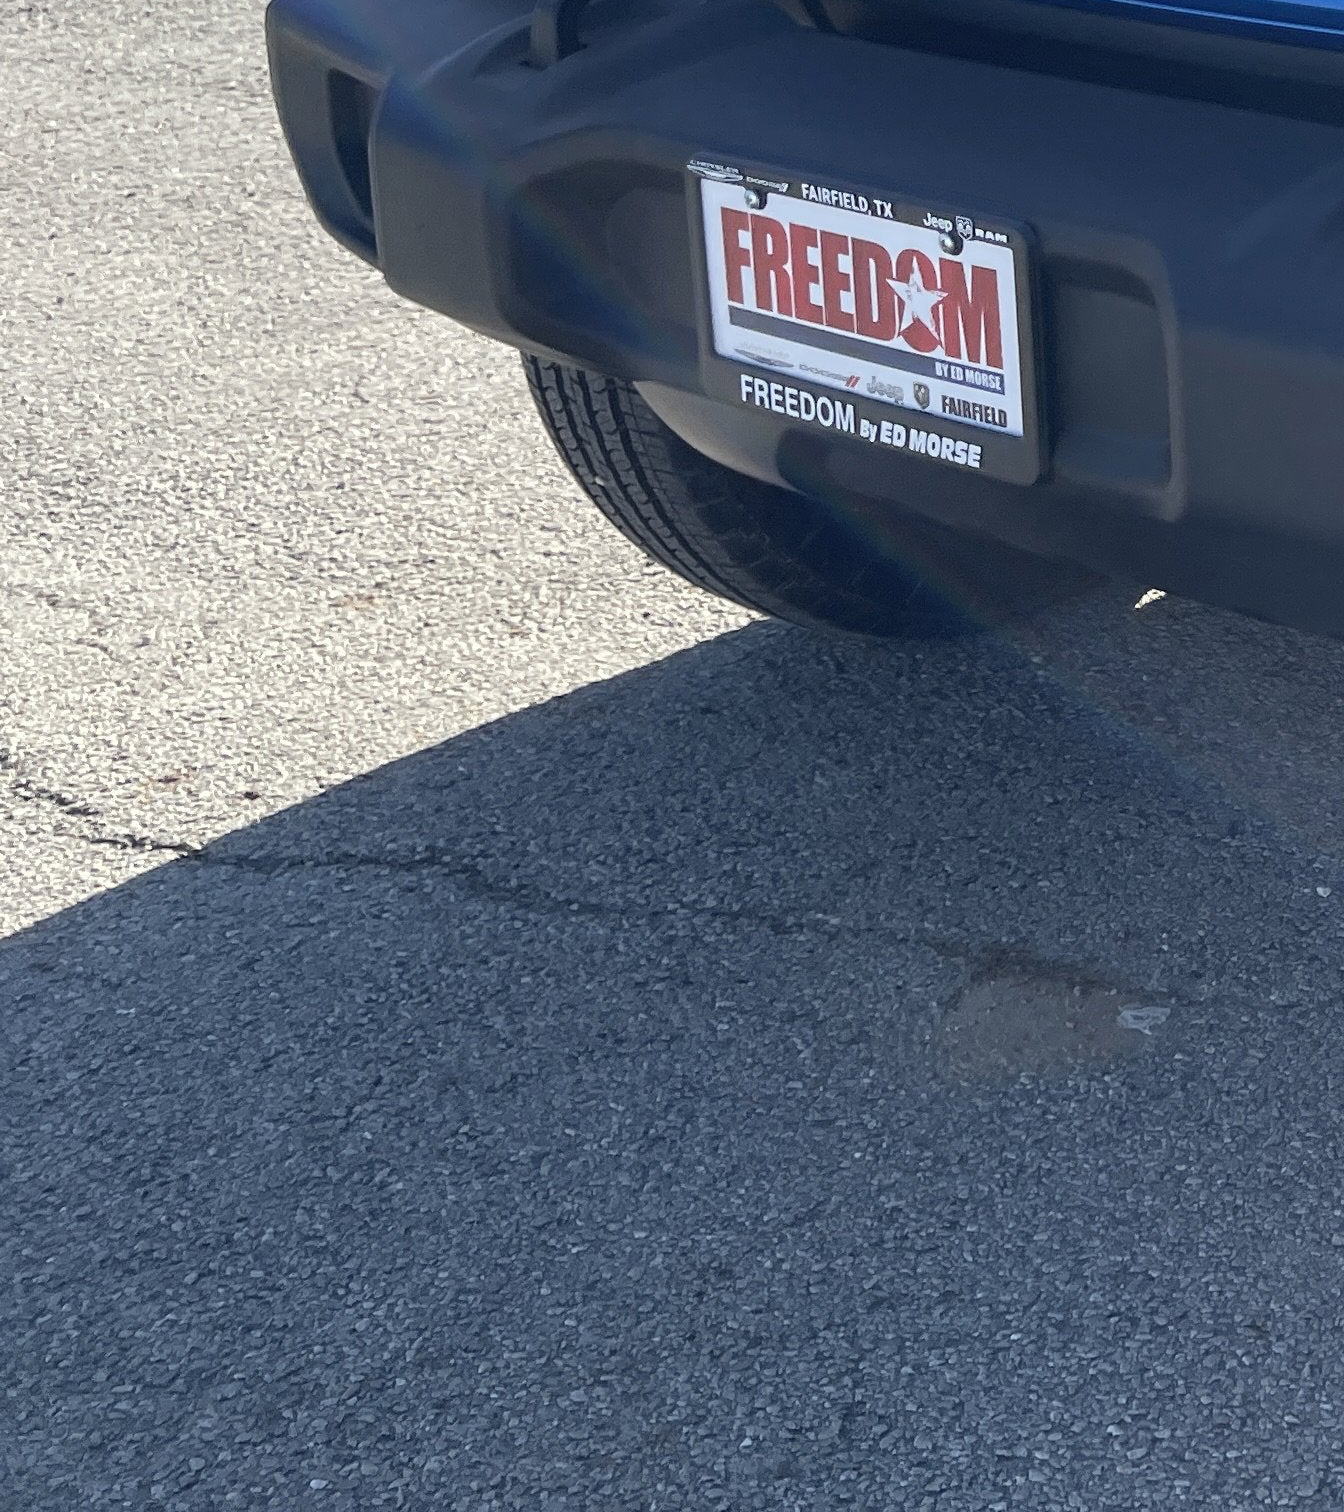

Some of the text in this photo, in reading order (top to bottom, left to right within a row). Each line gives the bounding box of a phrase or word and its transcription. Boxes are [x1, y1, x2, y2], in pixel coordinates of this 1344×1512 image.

[801, 183, 894, 219] FAIRFIELD, TX
[923, 212, 953, 233] Jeep
[720, 206, 1004, 370] FREEDOM
[866, 375, 905, 405] Jeep
[935, 360, 1002, 391] BY ED MORSE
[740, 373, 982, 469] FREEDOM By ED MORSE
[941, 394, 1008, 428] FAIRFIELD
